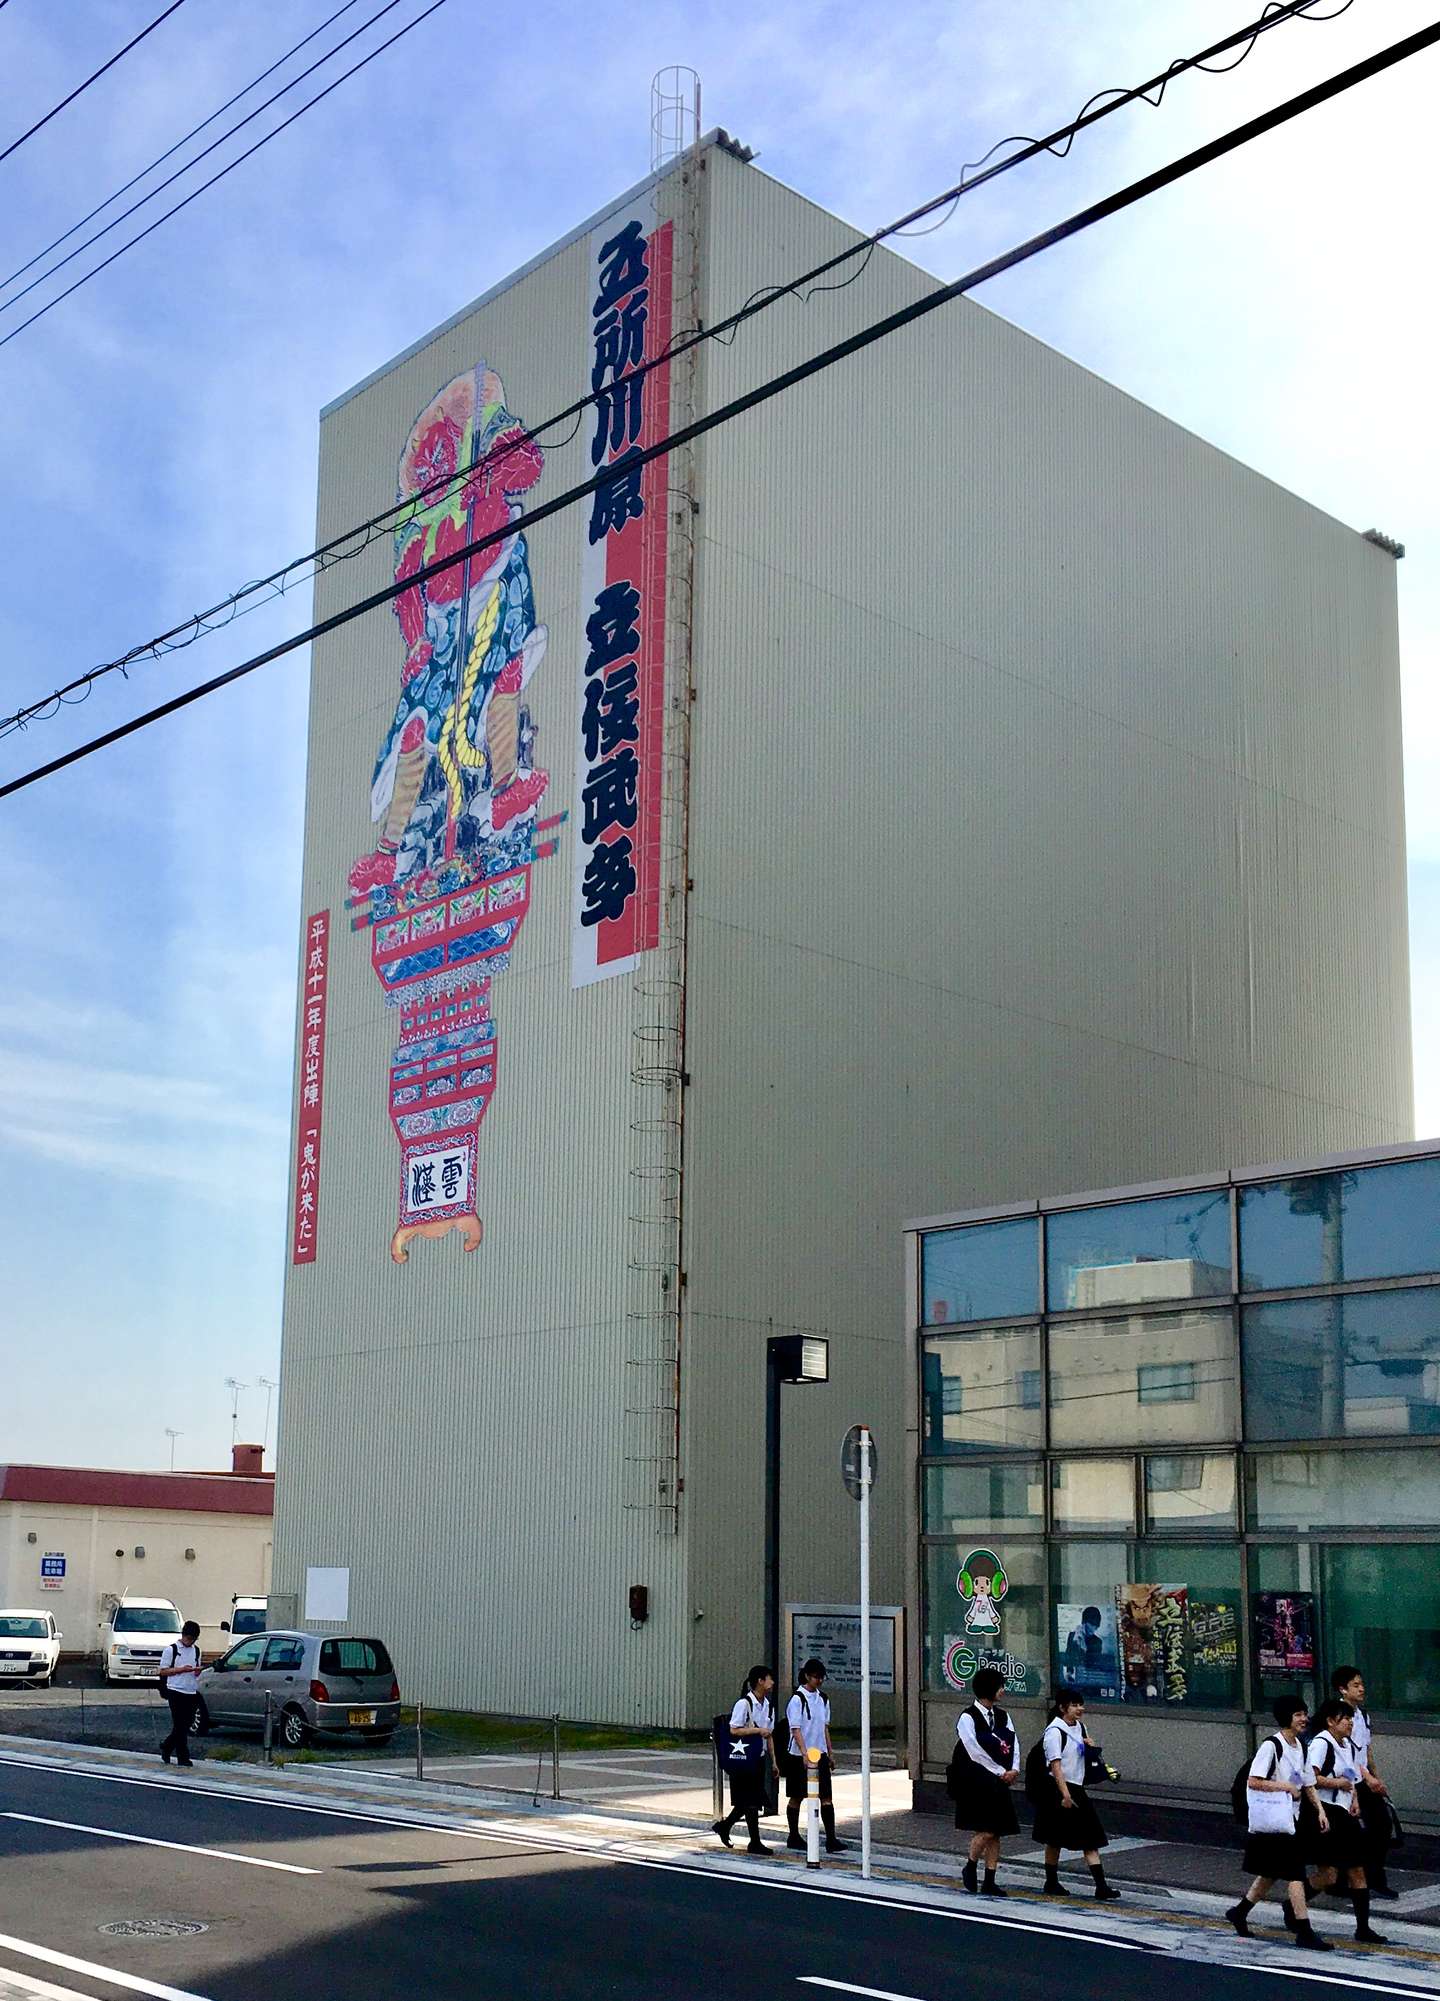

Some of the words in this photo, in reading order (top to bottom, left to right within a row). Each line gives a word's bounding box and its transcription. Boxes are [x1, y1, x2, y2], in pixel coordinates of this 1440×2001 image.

[588, 218, 650, 547] 五所川原
[303, 919, 326, 1109] 平成十一年度出陣
[977, 1652, 1026, 1679] Radio
